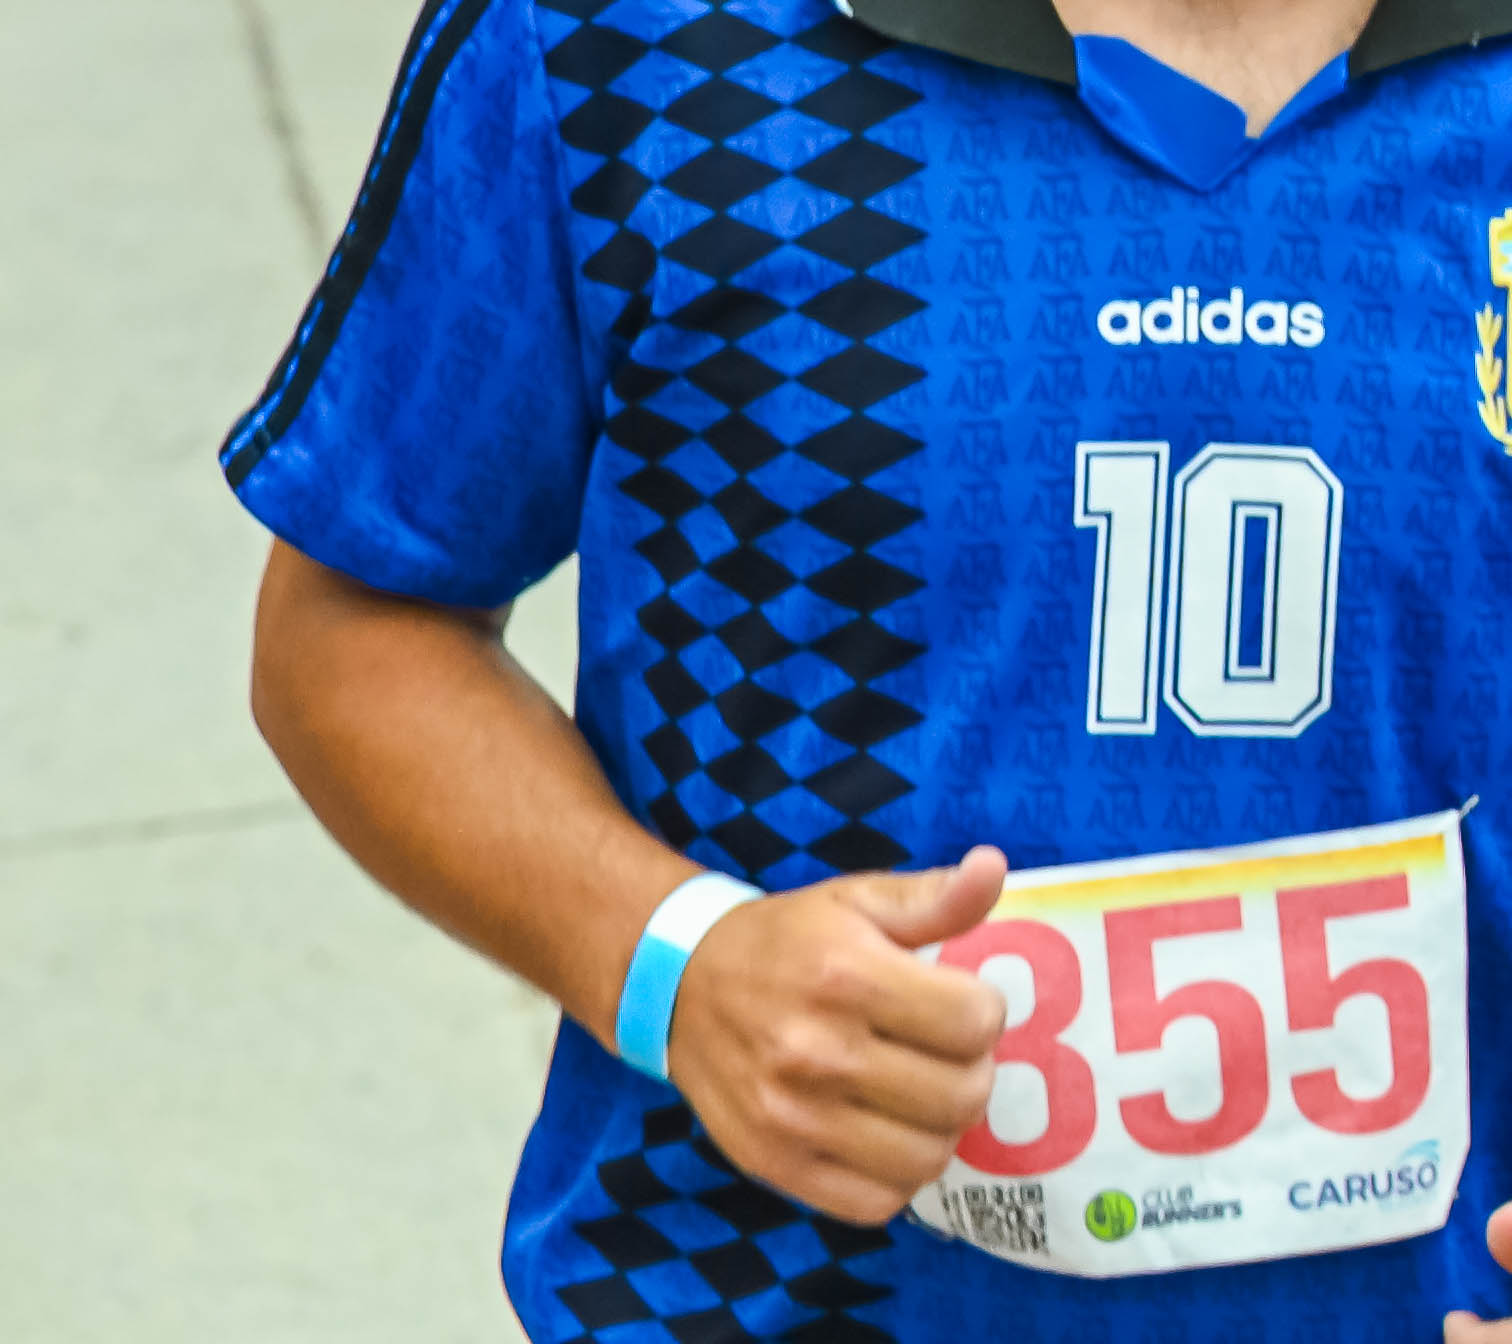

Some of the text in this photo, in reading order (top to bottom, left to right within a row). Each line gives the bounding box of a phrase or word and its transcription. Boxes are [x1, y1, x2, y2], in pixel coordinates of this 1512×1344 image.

[1096, 285, 1327, 348] adidas
[1073, 440, 1345, 740] 10
[938, 872, 1433, 1177] 855
[1288, 1160, 1438, 1211] CARUSO
